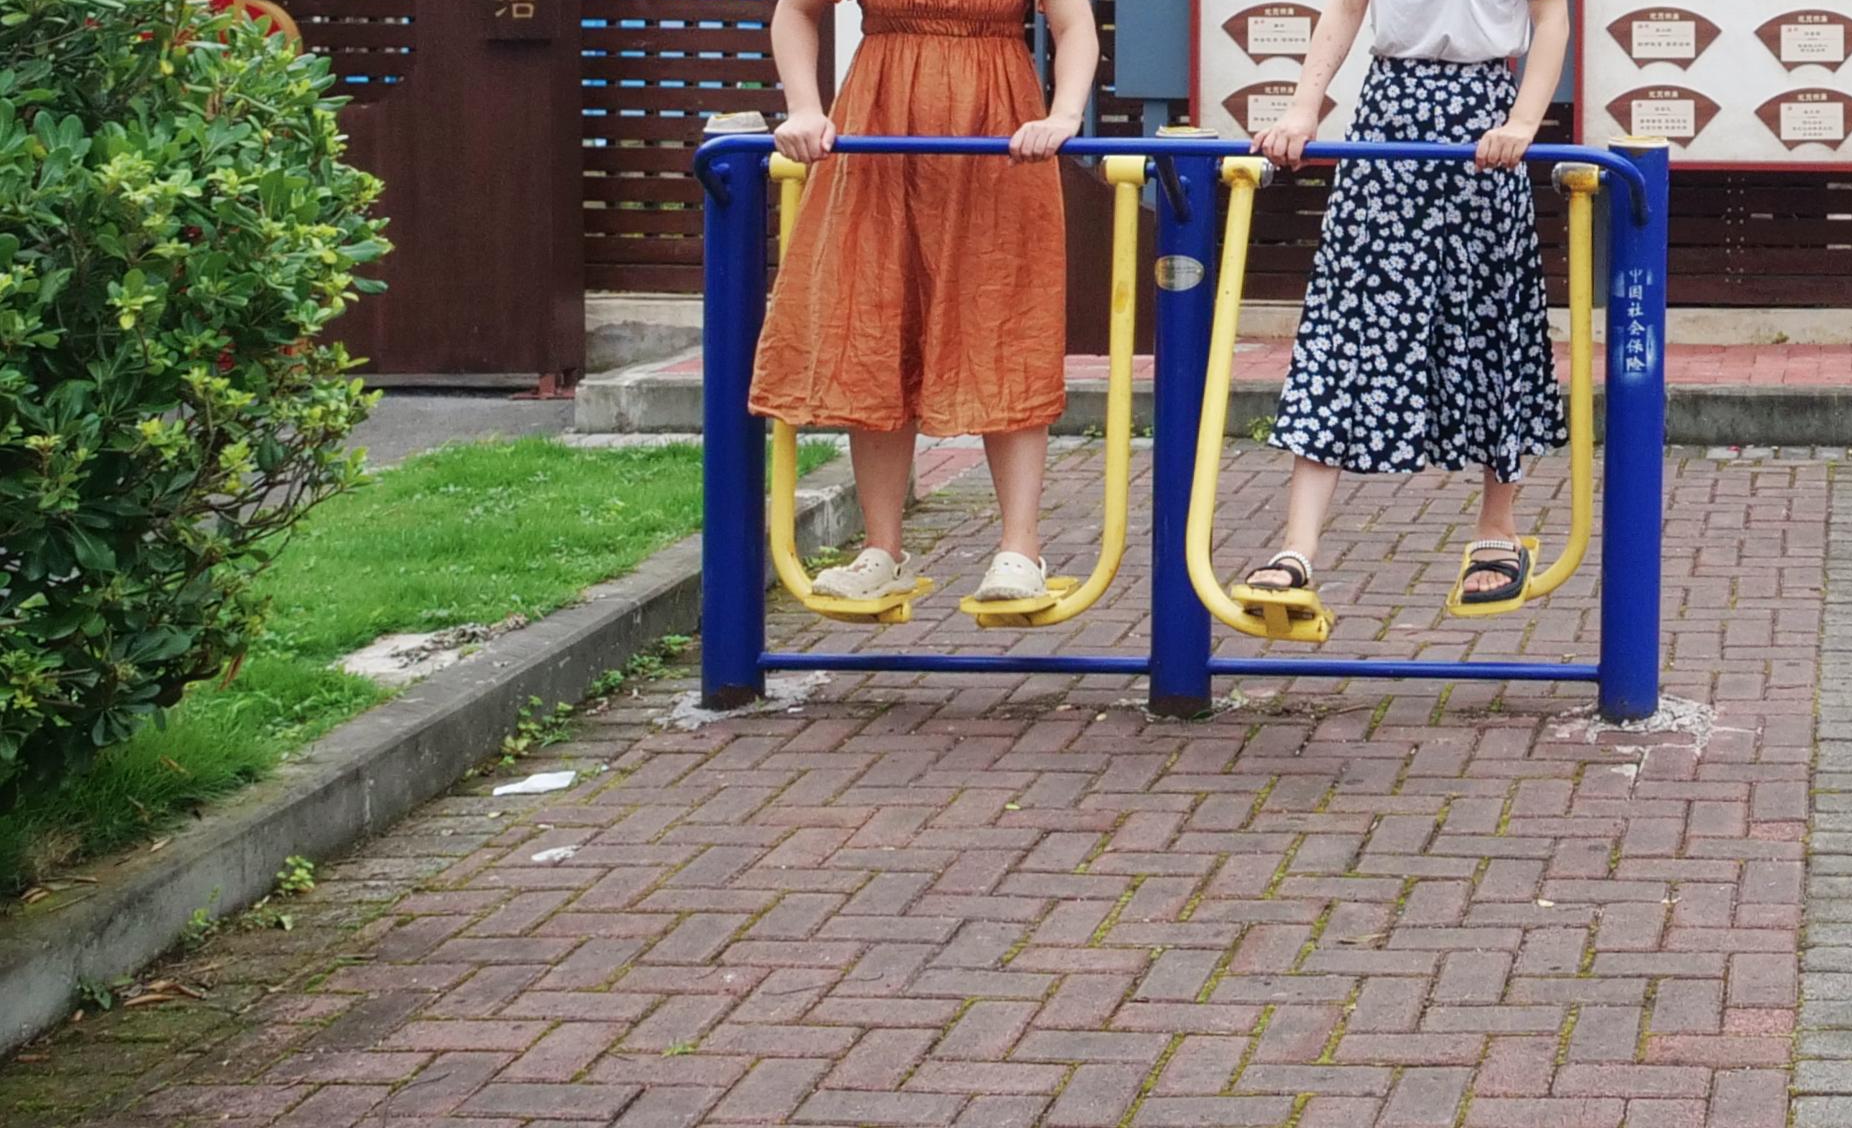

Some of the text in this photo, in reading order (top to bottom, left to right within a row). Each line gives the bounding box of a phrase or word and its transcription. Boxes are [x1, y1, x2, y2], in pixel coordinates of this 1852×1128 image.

[1625, 267, 1646, 372] 中国社会保险
